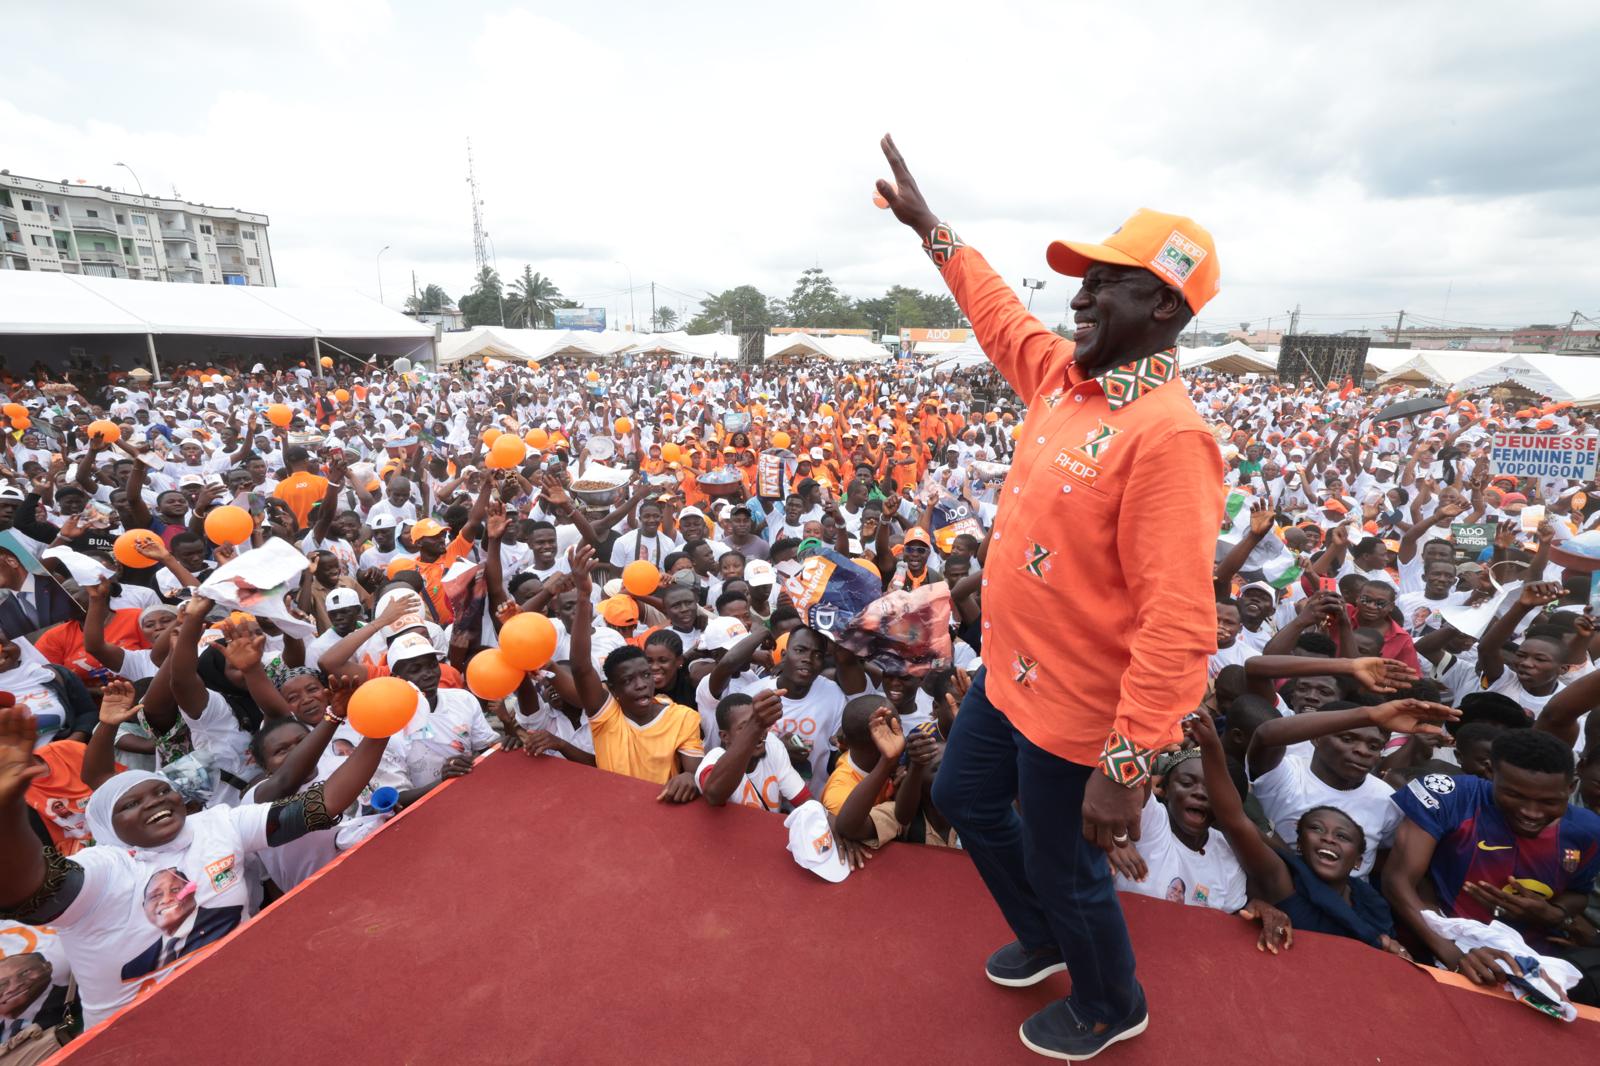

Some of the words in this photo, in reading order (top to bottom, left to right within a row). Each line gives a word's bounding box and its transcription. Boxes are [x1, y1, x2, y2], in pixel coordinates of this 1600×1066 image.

[926, 328, 951, 340] ADO
[1495, 435, 1597, 451] JEUNESSE
[1055, 452, 1097, 478] RHDP
[1492, 448, 1572, 465] FEMININE
[1576, 452, 1595, 465] DE
[1497, 462, 1585, 479] YOPOUGON
[945, 505, 968, 522] ADO
[1459, 527, 1484, 536] ADO
[1456, 538, 1488, 546] NATION
[207, 857, 234, 874] RHDP
